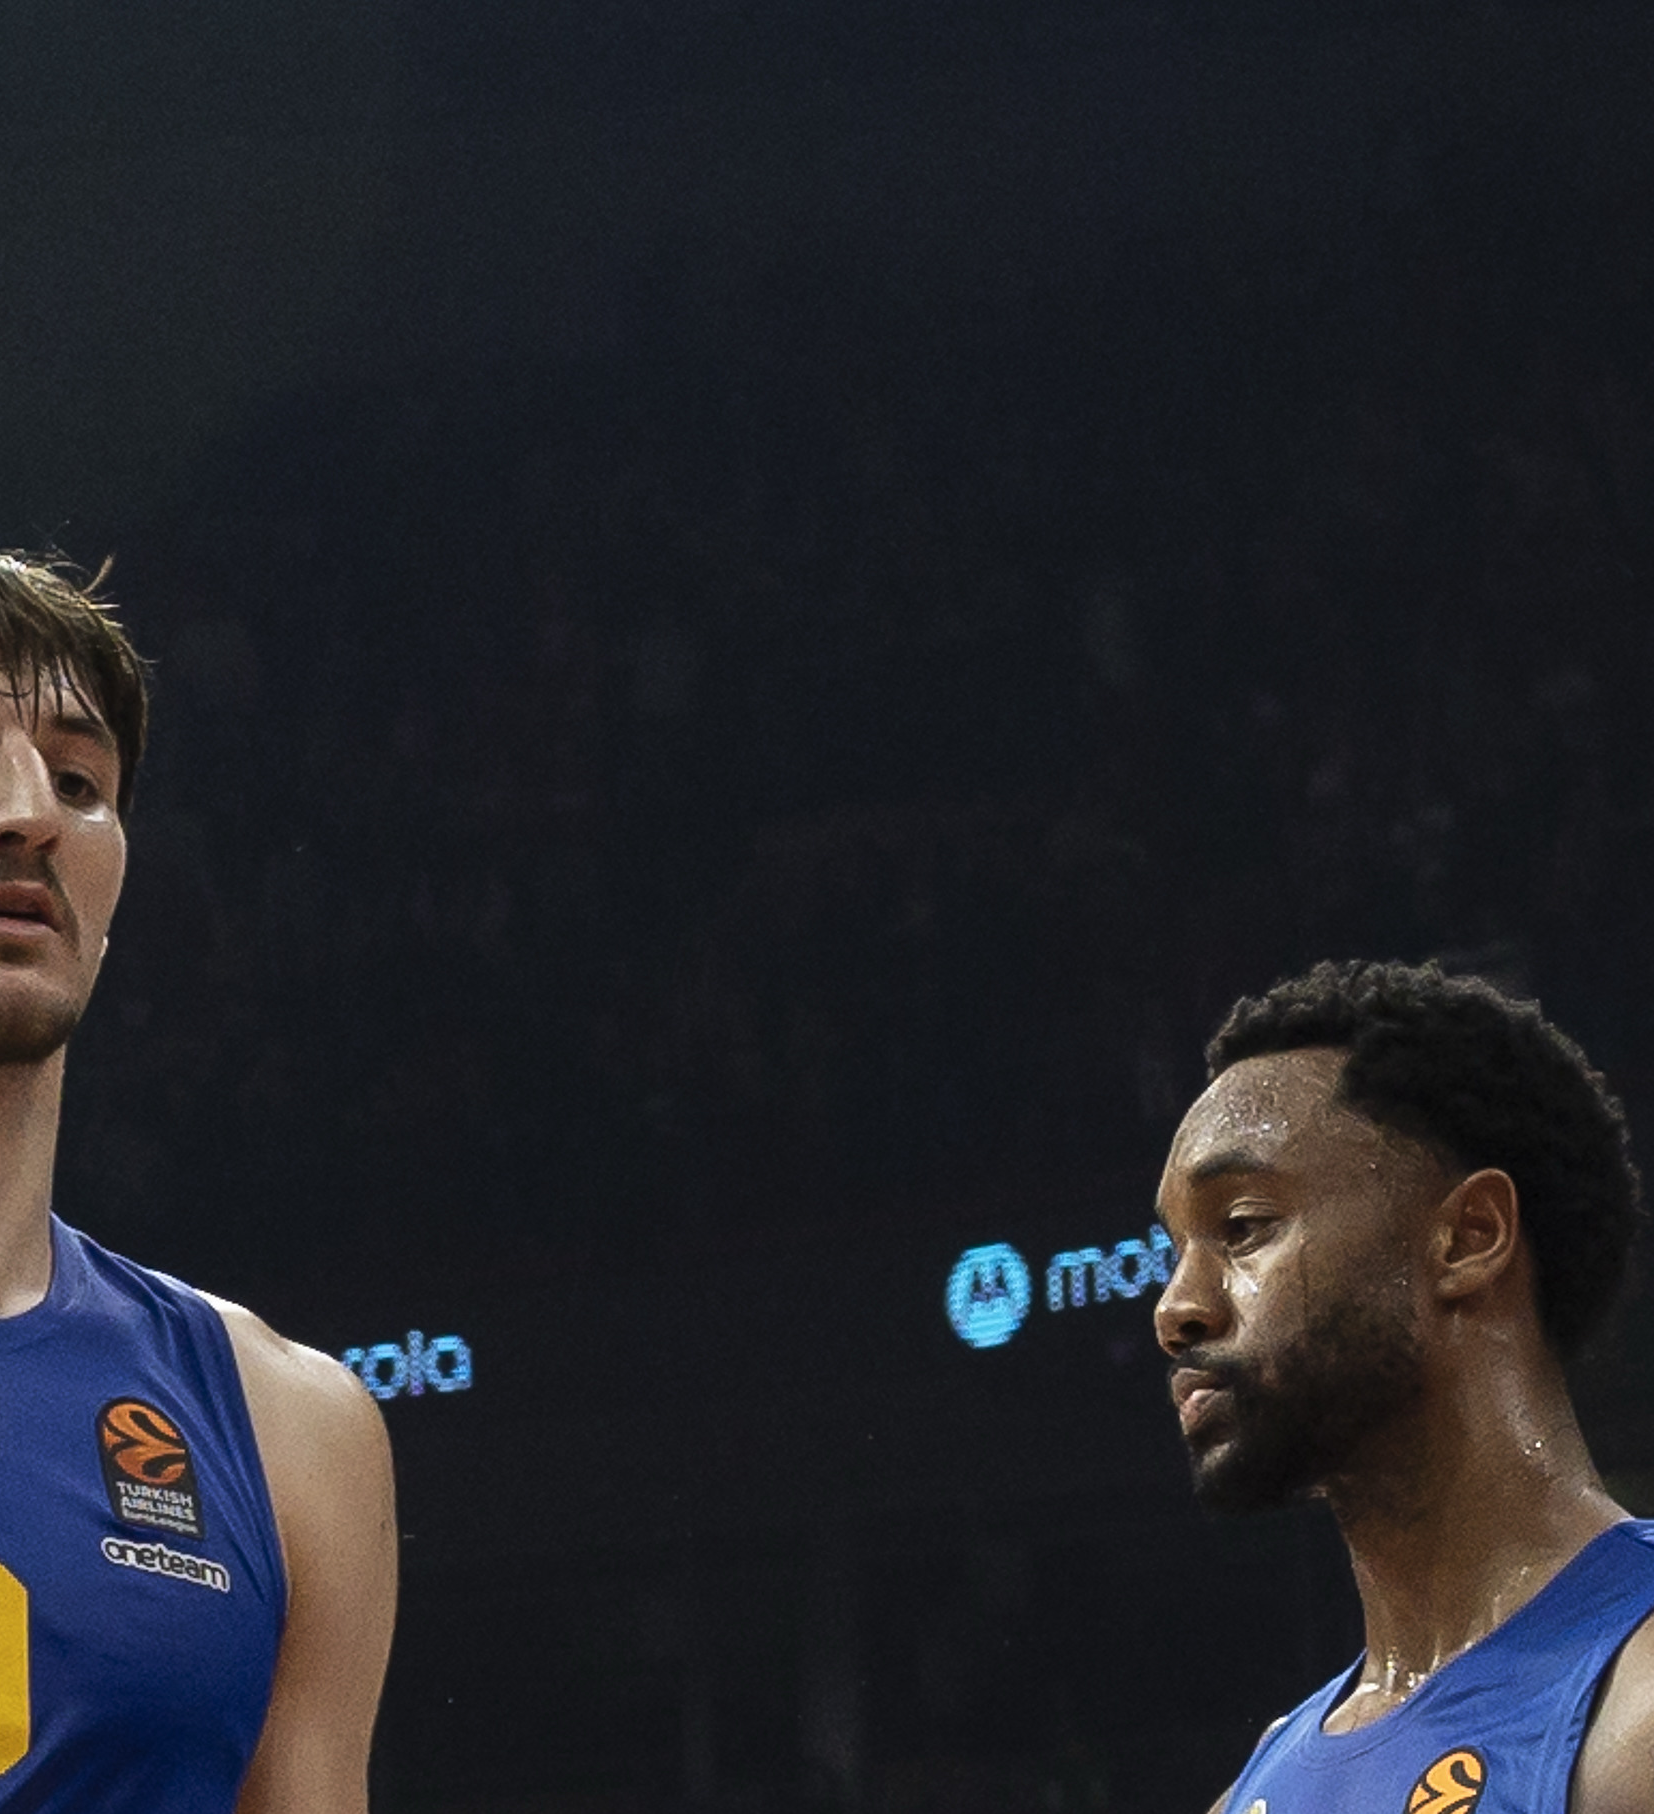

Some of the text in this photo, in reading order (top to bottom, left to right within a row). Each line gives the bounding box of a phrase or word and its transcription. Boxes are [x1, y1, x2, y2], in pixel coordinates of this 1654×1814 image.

[115, 1481, 194, 1508] TURKISH
[120, 1496, 197, 1521] AIRLINES
[103, 1539, 230, 1591] oneteam
